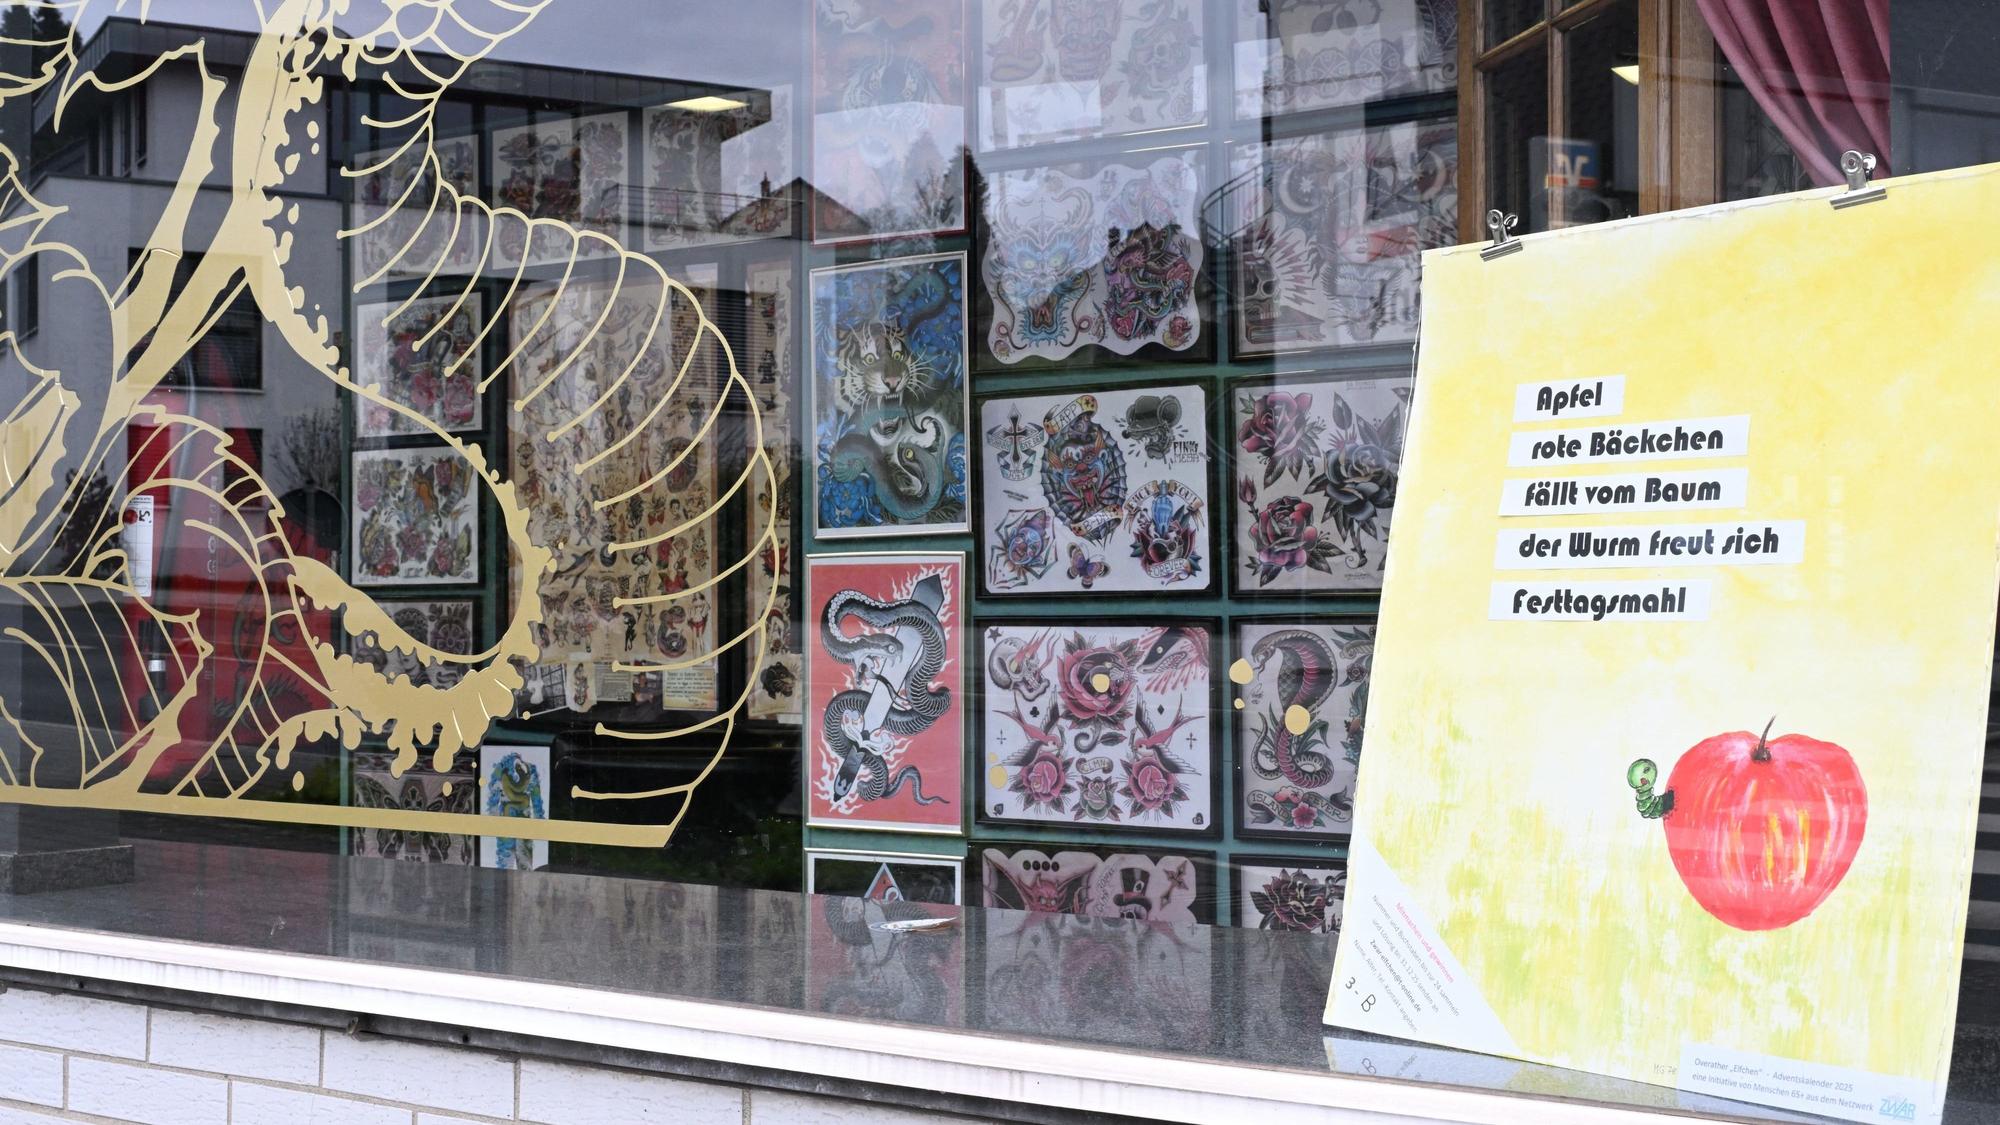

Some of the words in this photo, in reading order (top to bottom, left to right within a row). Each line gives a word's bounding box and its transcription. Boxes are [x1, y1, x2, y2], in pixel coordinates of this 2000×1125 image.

[1536, 381, 1603, 416] Apfel
[1531, 434, 1582, 460] rote
[1589, 426, 1724, 457] Bäckchen
[1524, 481, 1578, 507] fällt
[1585, 484, 1636, 505] vom
[1644, 477, 1721, 503] Baum
[1519, 533, 1562, 558] der
[1568, 532, 1640, 558] Wurm
[1721, 526, 1779, 554] sich
[1512, 587, 1686, 621] Festtagsmahl
[1252, 793, 1290, 821] ISLAND
[1306, 795, 1345, 820] FEVER
[1345, 976, 1356, 990] 3
[1360, 993, 1377, 1013] B
[1694, 1058, 1728, 1071] Overather
[1773, 1072, 1832, 1088] Adventskalender
[1834, 1082, 1854, 1093] 2025
[1692, 1073, 1707, 1082] eine
[1740, 1082, 1752, 1090] von
[1753, 1083, 1790, 1097] Menschen
[1791, 1089, 1805, 1099] 65+
[1806, 1094, 1819, 1102] aus
[1820, 1095, 1837, 1105] dem
[1839, 1098, 1874, 1113] Netzwerk
[1880, 1097, 1916, 1118] ZWAR
